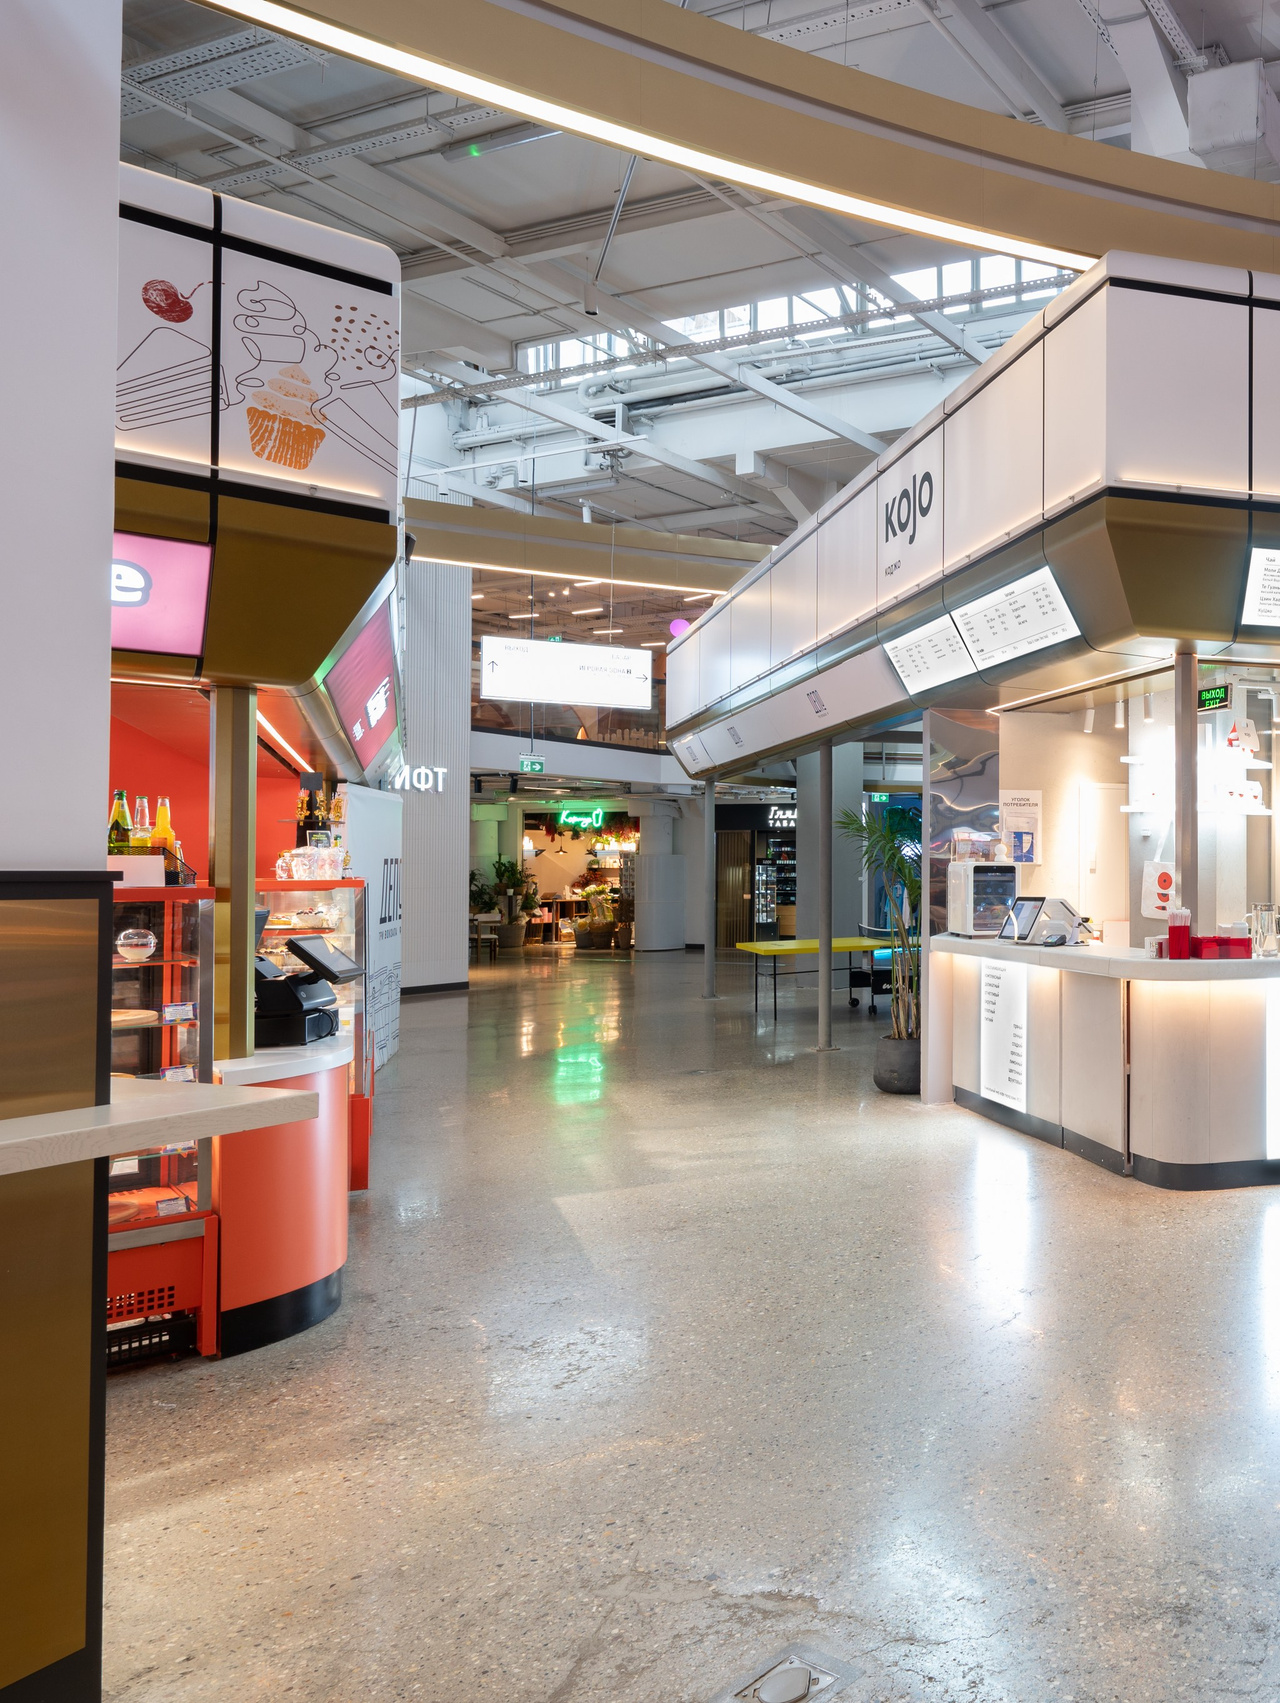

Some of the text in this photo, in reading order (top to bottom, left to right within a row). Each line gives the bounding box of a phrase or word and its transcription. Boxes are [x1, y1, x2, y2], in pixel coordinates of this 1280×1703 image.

[885, 471, 933, 545] KOJO
[1202, 688, 1225, 700] ВЫХОД
[1206, 700, 1220, 708] EXIT
[388, 765, 447, 792] ИФТ
